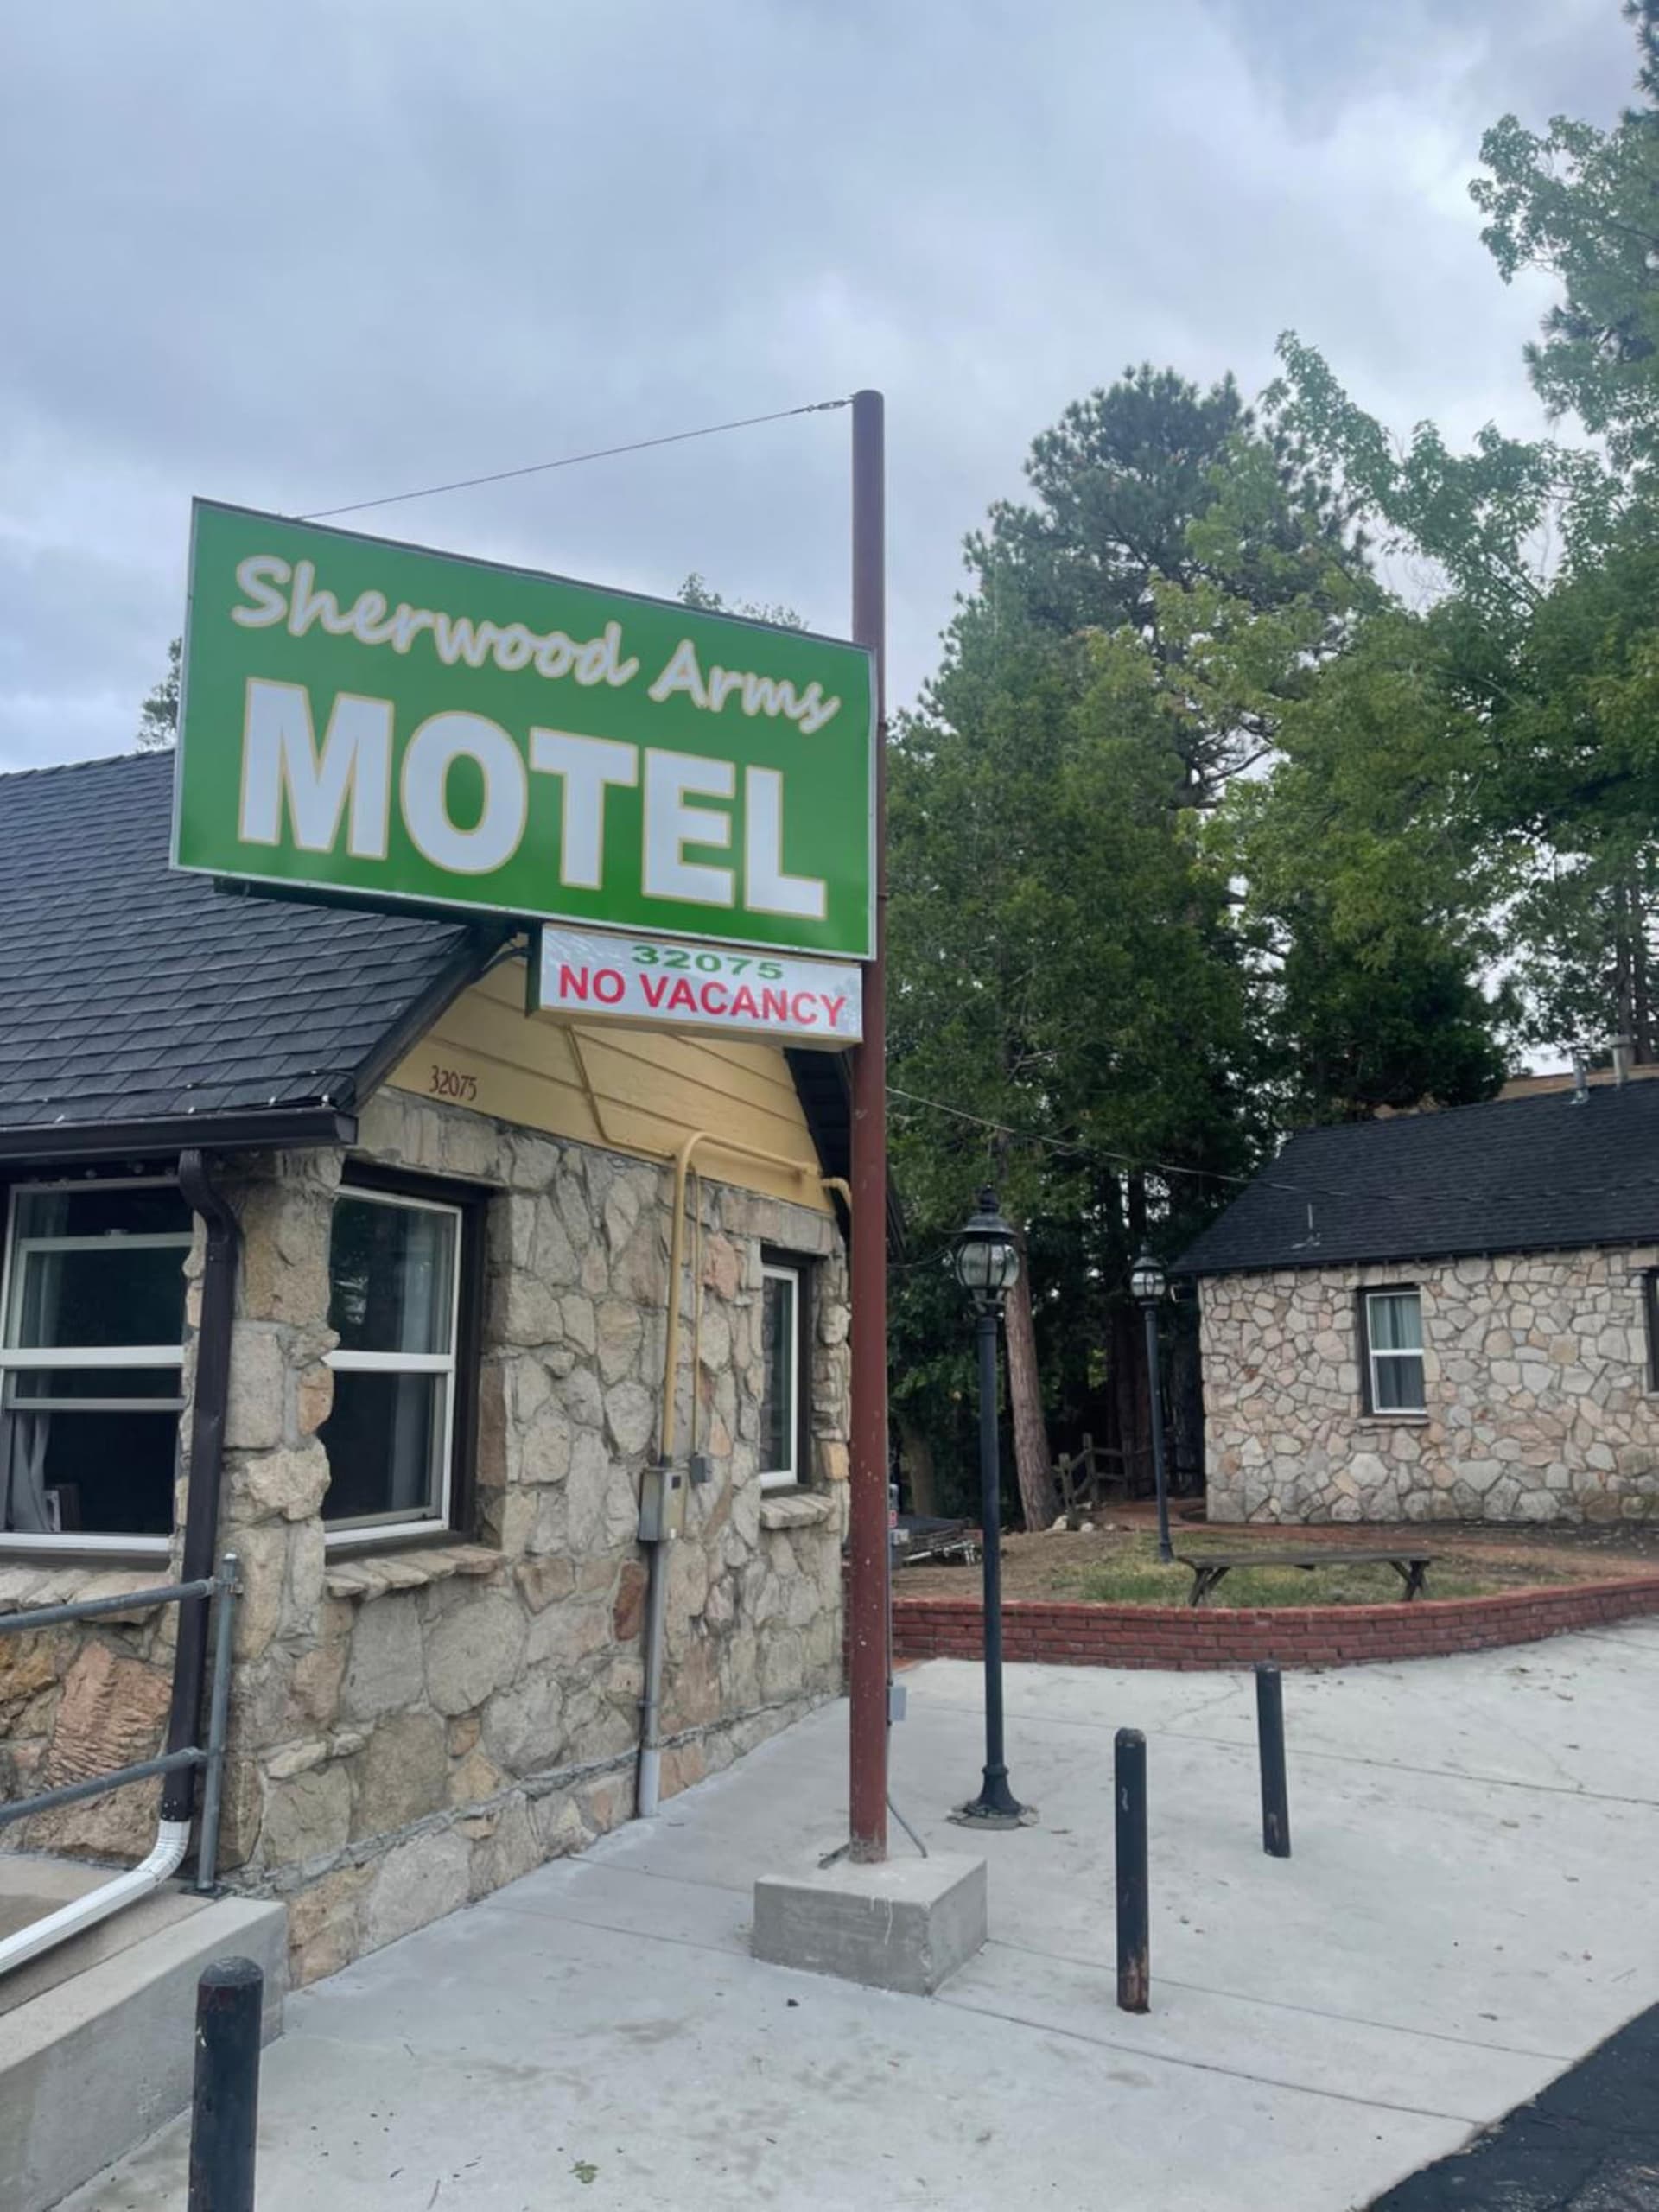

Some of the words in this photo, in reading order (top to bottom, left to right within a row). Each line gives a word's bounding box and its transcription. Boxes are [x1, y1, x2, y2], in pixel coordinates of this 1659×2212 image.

[232, 555, 639, 686] Sherwood
[648, 640, 841, 734] Arms
[238, 677, 827, 920] MOTEL
[632, 945, 784, 980] 32075
[559, 964, 626, 1004] NO
[639, 973, 846, 1027] VACANCY
[429, 1065, 477, 1102] 32075
